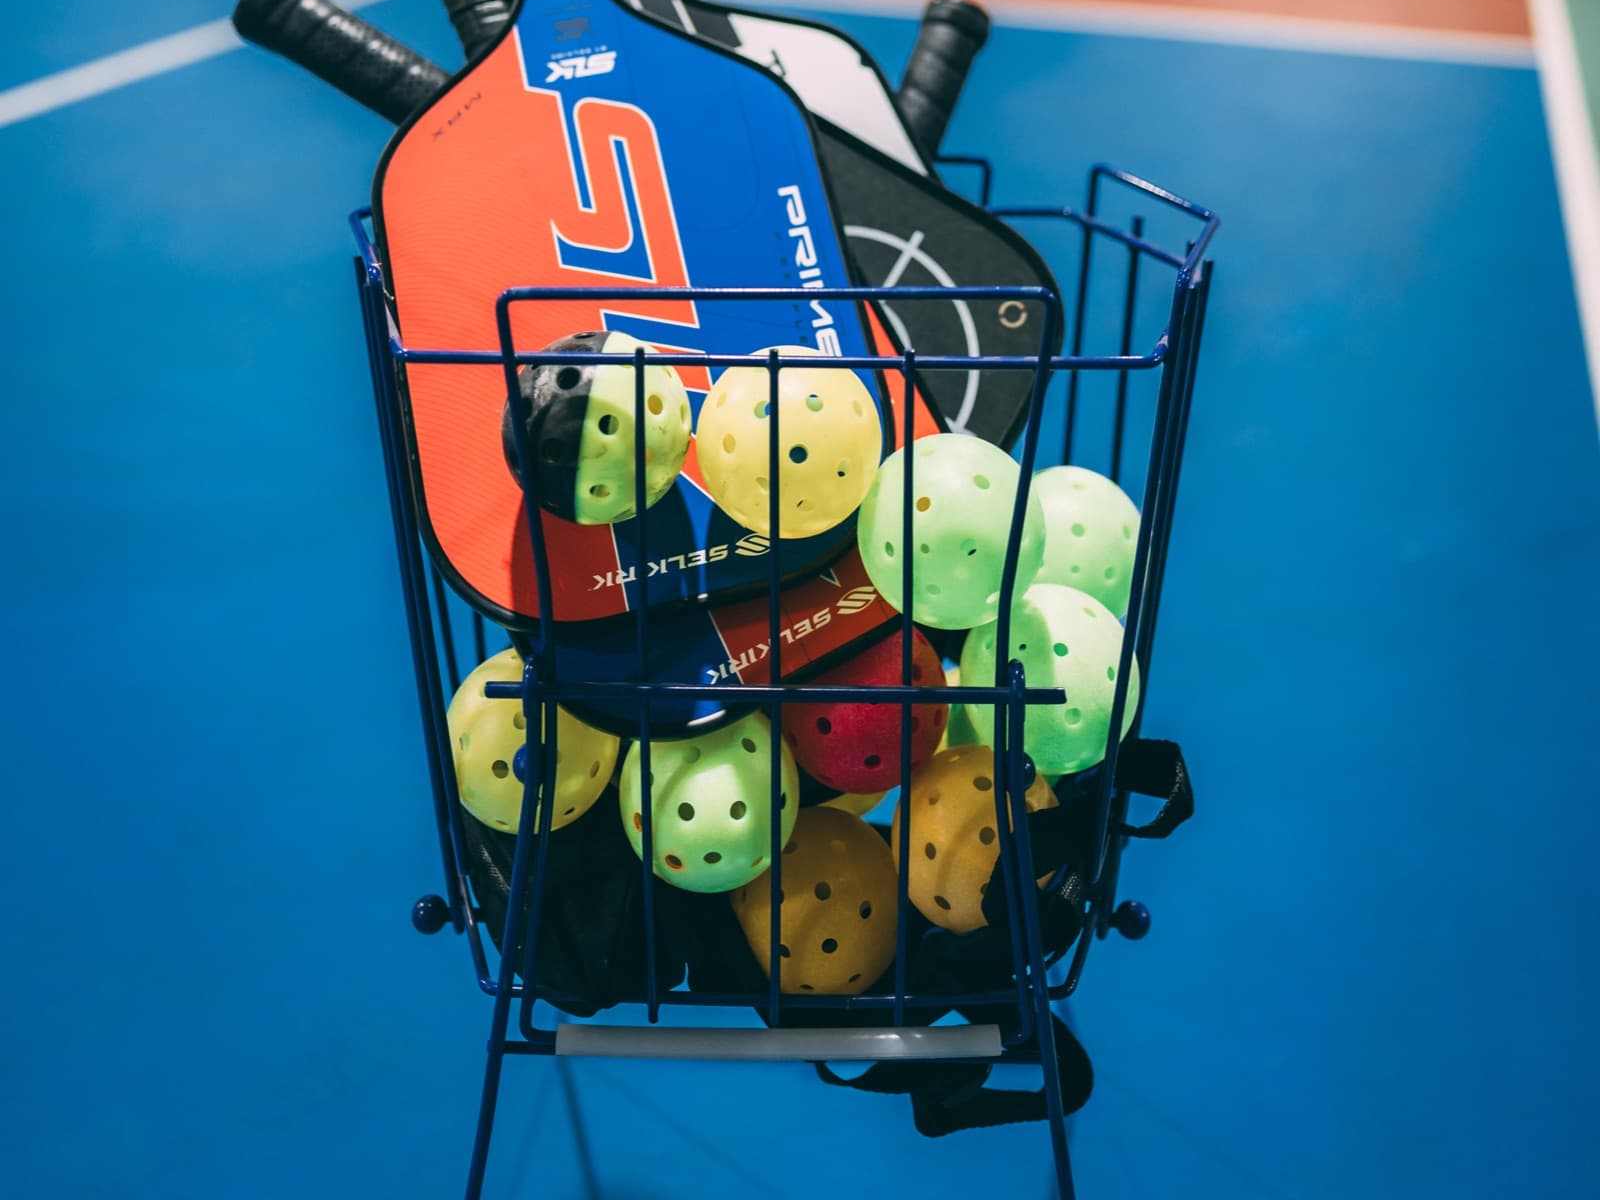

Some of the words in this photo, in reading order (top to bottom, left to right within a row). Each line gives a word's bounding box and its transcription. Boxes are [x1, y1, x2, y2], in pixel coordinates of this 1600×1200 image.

[545, 51, 617, 83] SLK
[777, 184, 843, 357] PRIME
[592, 543, 729, 591] SELKRK
